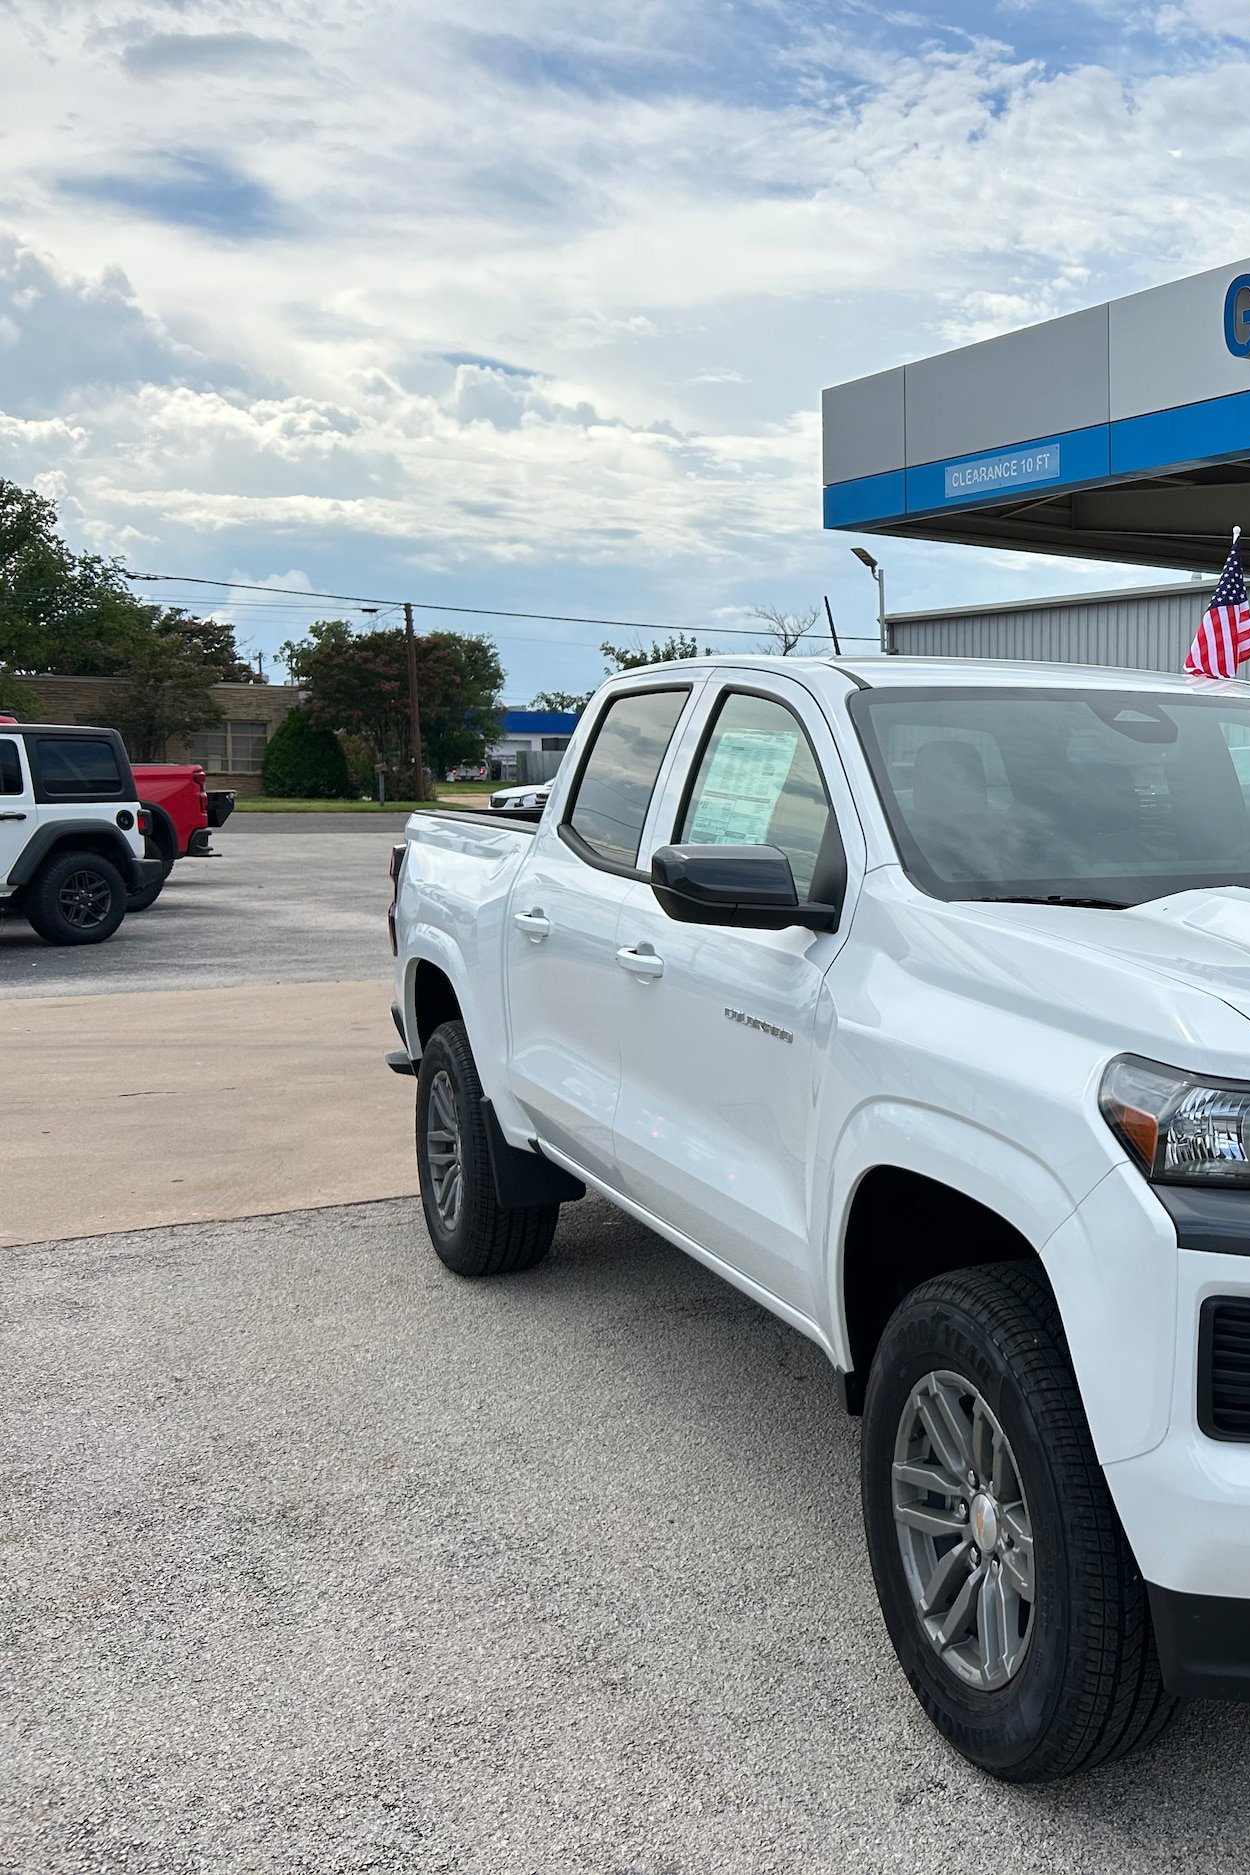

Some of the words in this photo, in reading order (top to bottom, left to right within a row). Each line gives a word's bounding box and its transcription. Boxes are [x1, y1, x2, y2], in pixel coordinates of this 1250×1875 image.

[952, 460, 1017, 487] CLEARANCE
[1021, 458, 1033, 473] 10
[1036, 453, 1051, 471] FT
